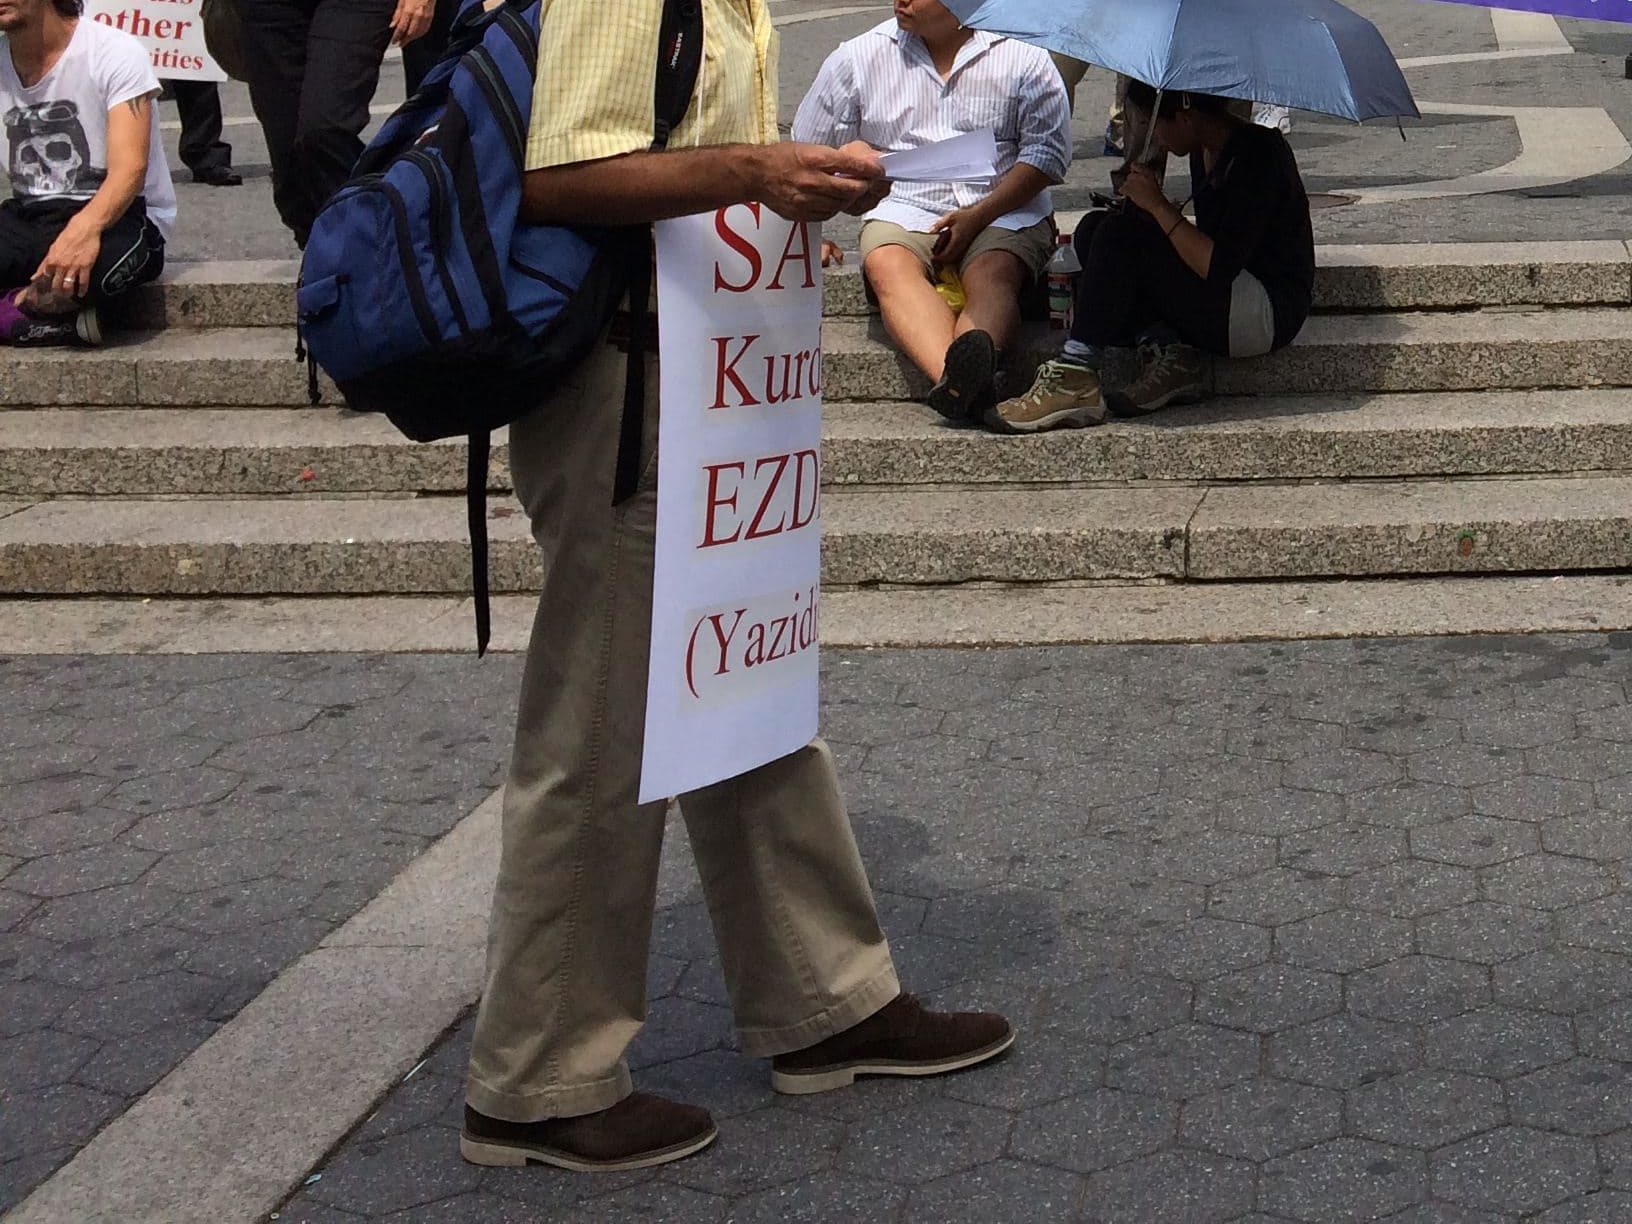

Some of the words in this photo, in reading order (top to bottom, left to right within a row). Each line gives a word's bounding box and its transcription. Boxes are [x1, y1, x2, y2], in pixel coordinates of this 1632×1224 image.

[94, 9, 193, 40] other
[713, 202, 816, 294] SA
[696, 448, 820, 550] EZD
